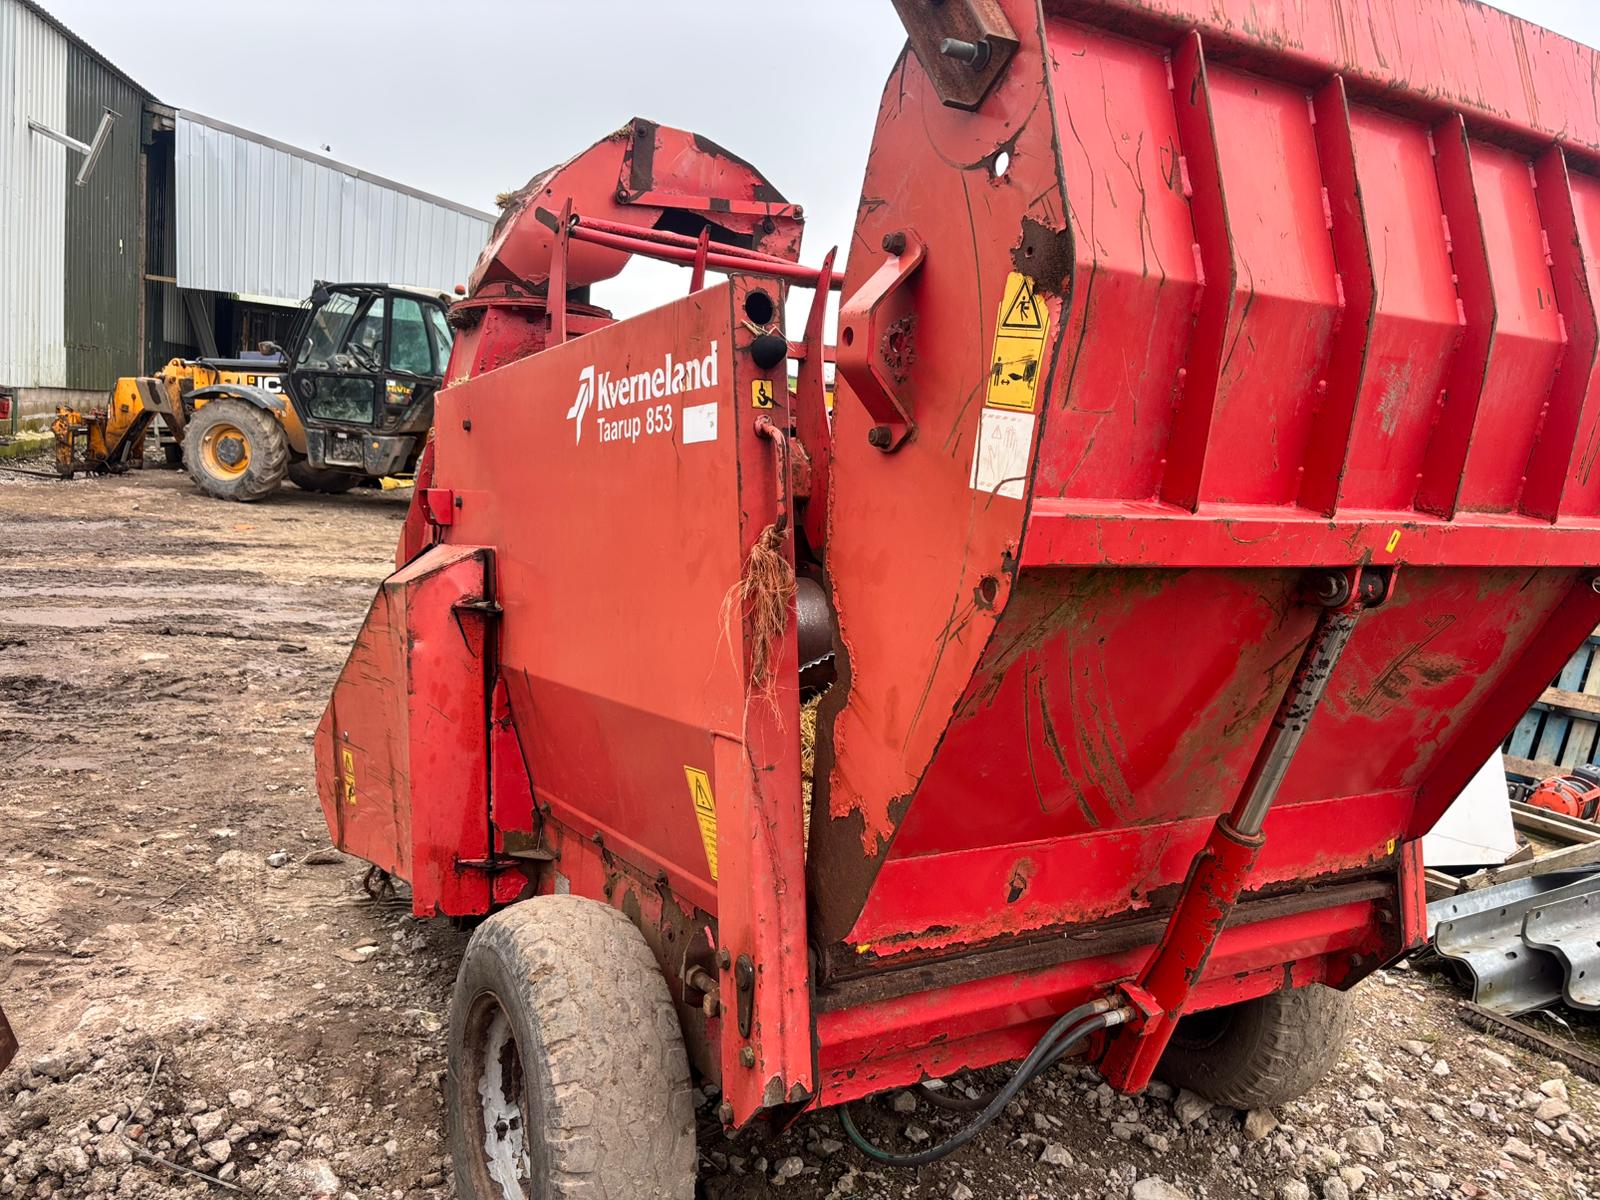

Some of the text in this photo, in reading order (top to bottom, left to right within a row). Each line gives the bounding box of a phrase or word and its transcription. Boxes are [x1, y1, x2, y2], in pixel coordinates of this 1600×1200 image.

[257, 376, 286, 393] JC
[597, 339, 719, 412] Kverneland
[597, 403, 673, 444] Taarup 853
